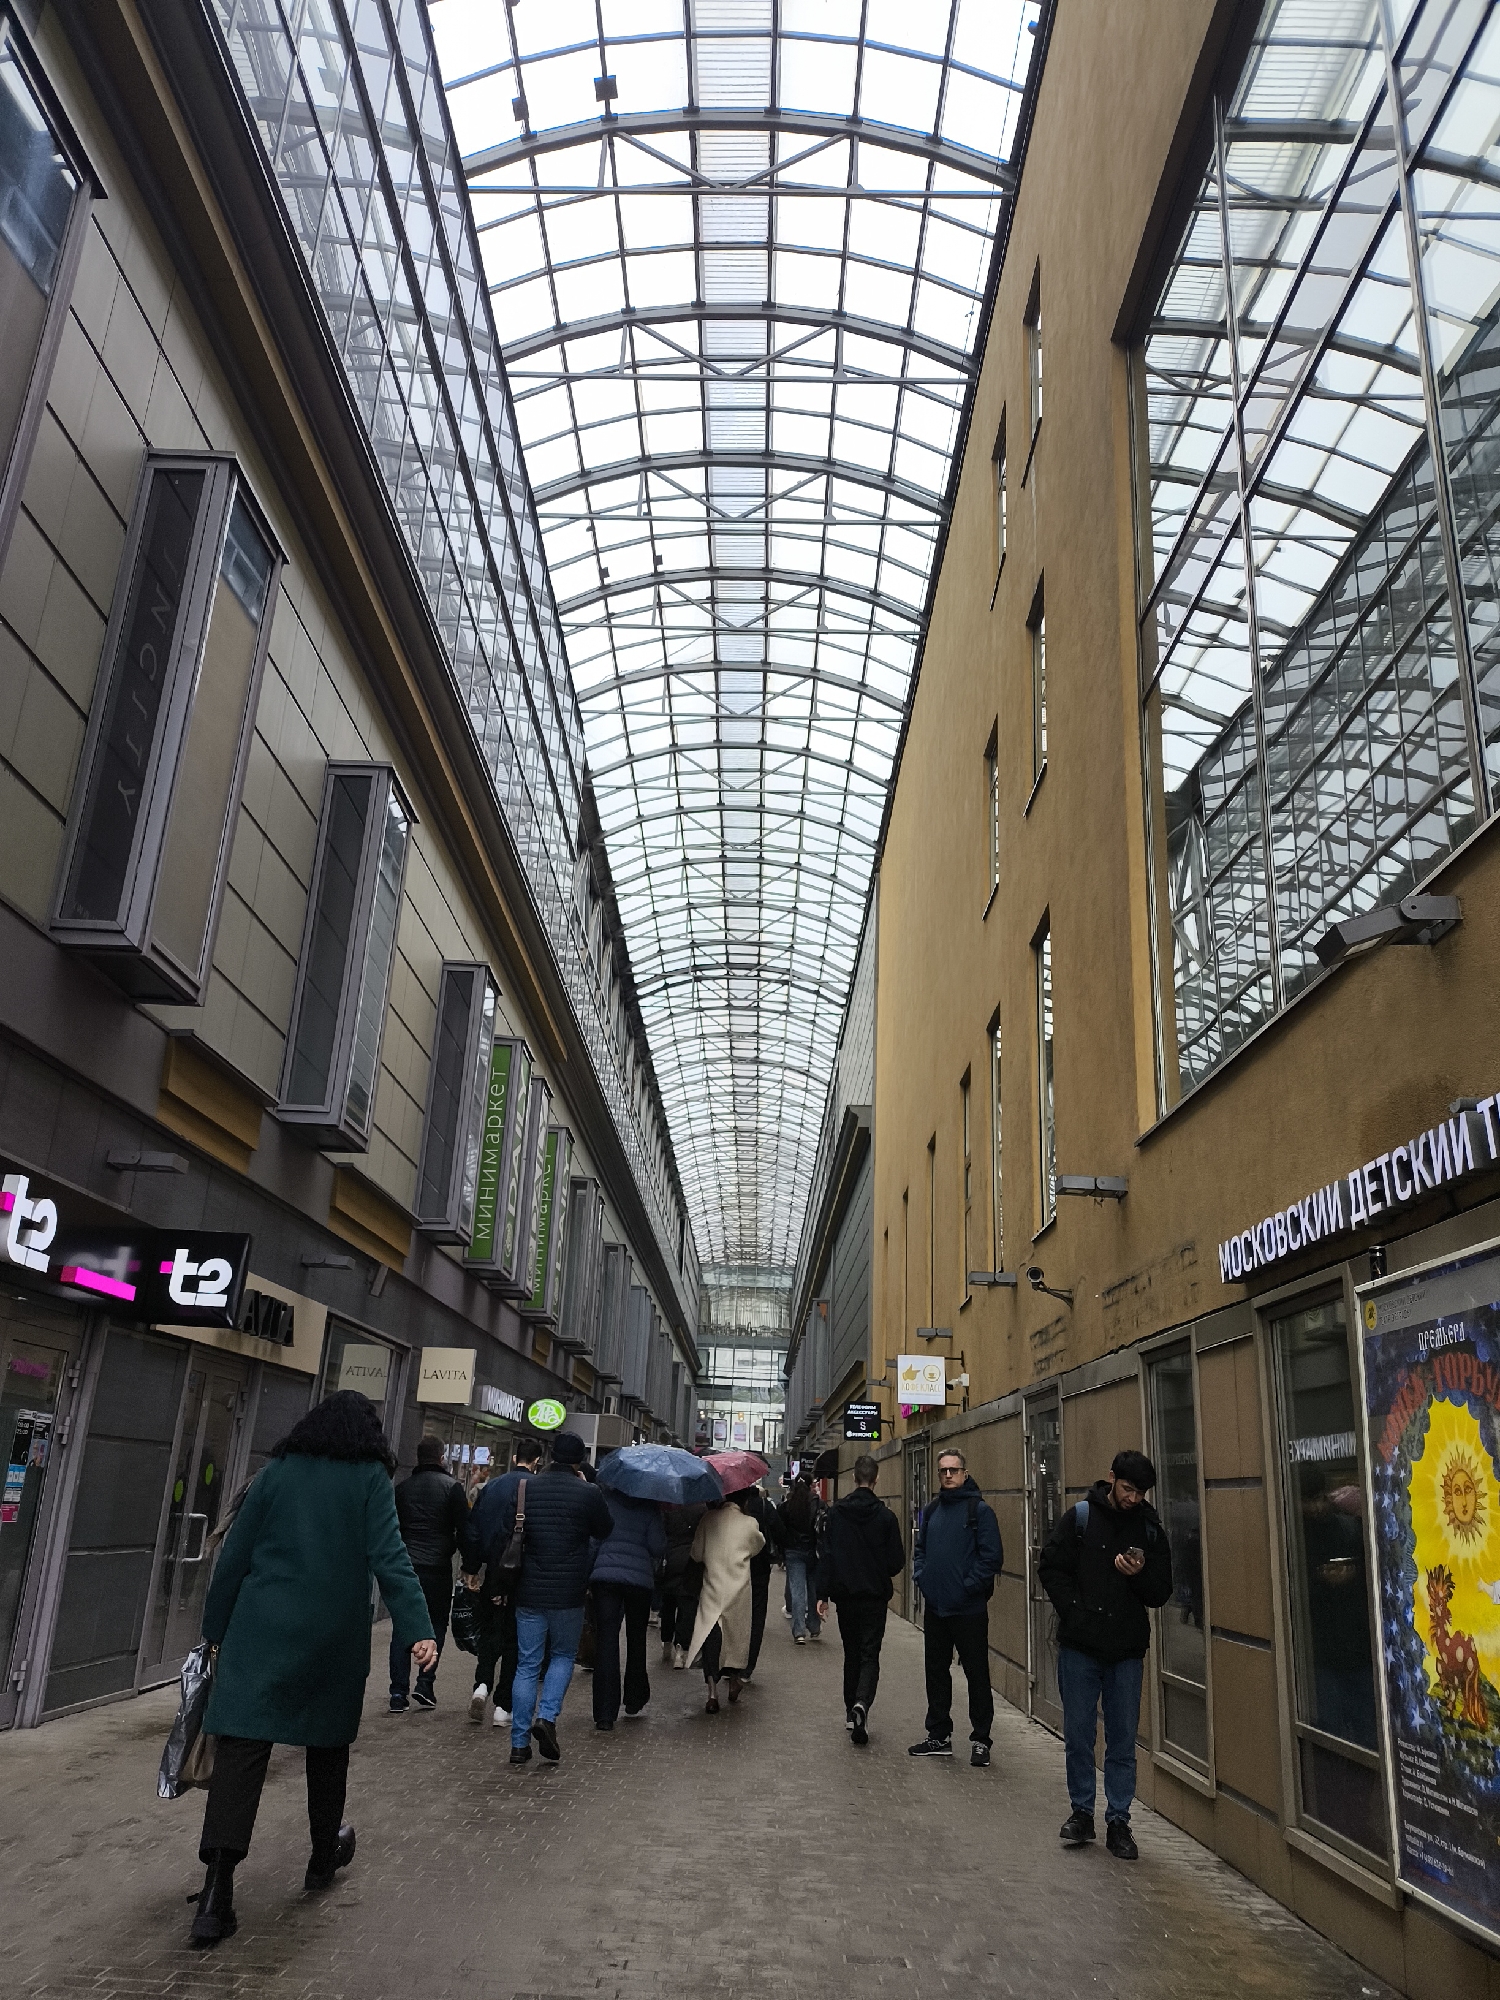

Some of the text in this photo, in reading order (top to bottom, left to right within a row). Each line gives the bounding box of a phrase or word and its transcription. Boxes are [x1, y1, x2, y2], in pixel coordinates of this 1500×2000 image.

[117, 546, 178, 817] INCITY
[476, 1066, 506, 1240] минимаркет
[508, 1062, 528, 1217] DAILY
[1476, 1091, 1500, 1160] Т
[1, 1174, 58, 1273] t2
[168, 1248, 233, 1307] t2
[240, 1288, 295, 1347] AVITA
[422, 1369, 468, 1381] LAVITA
